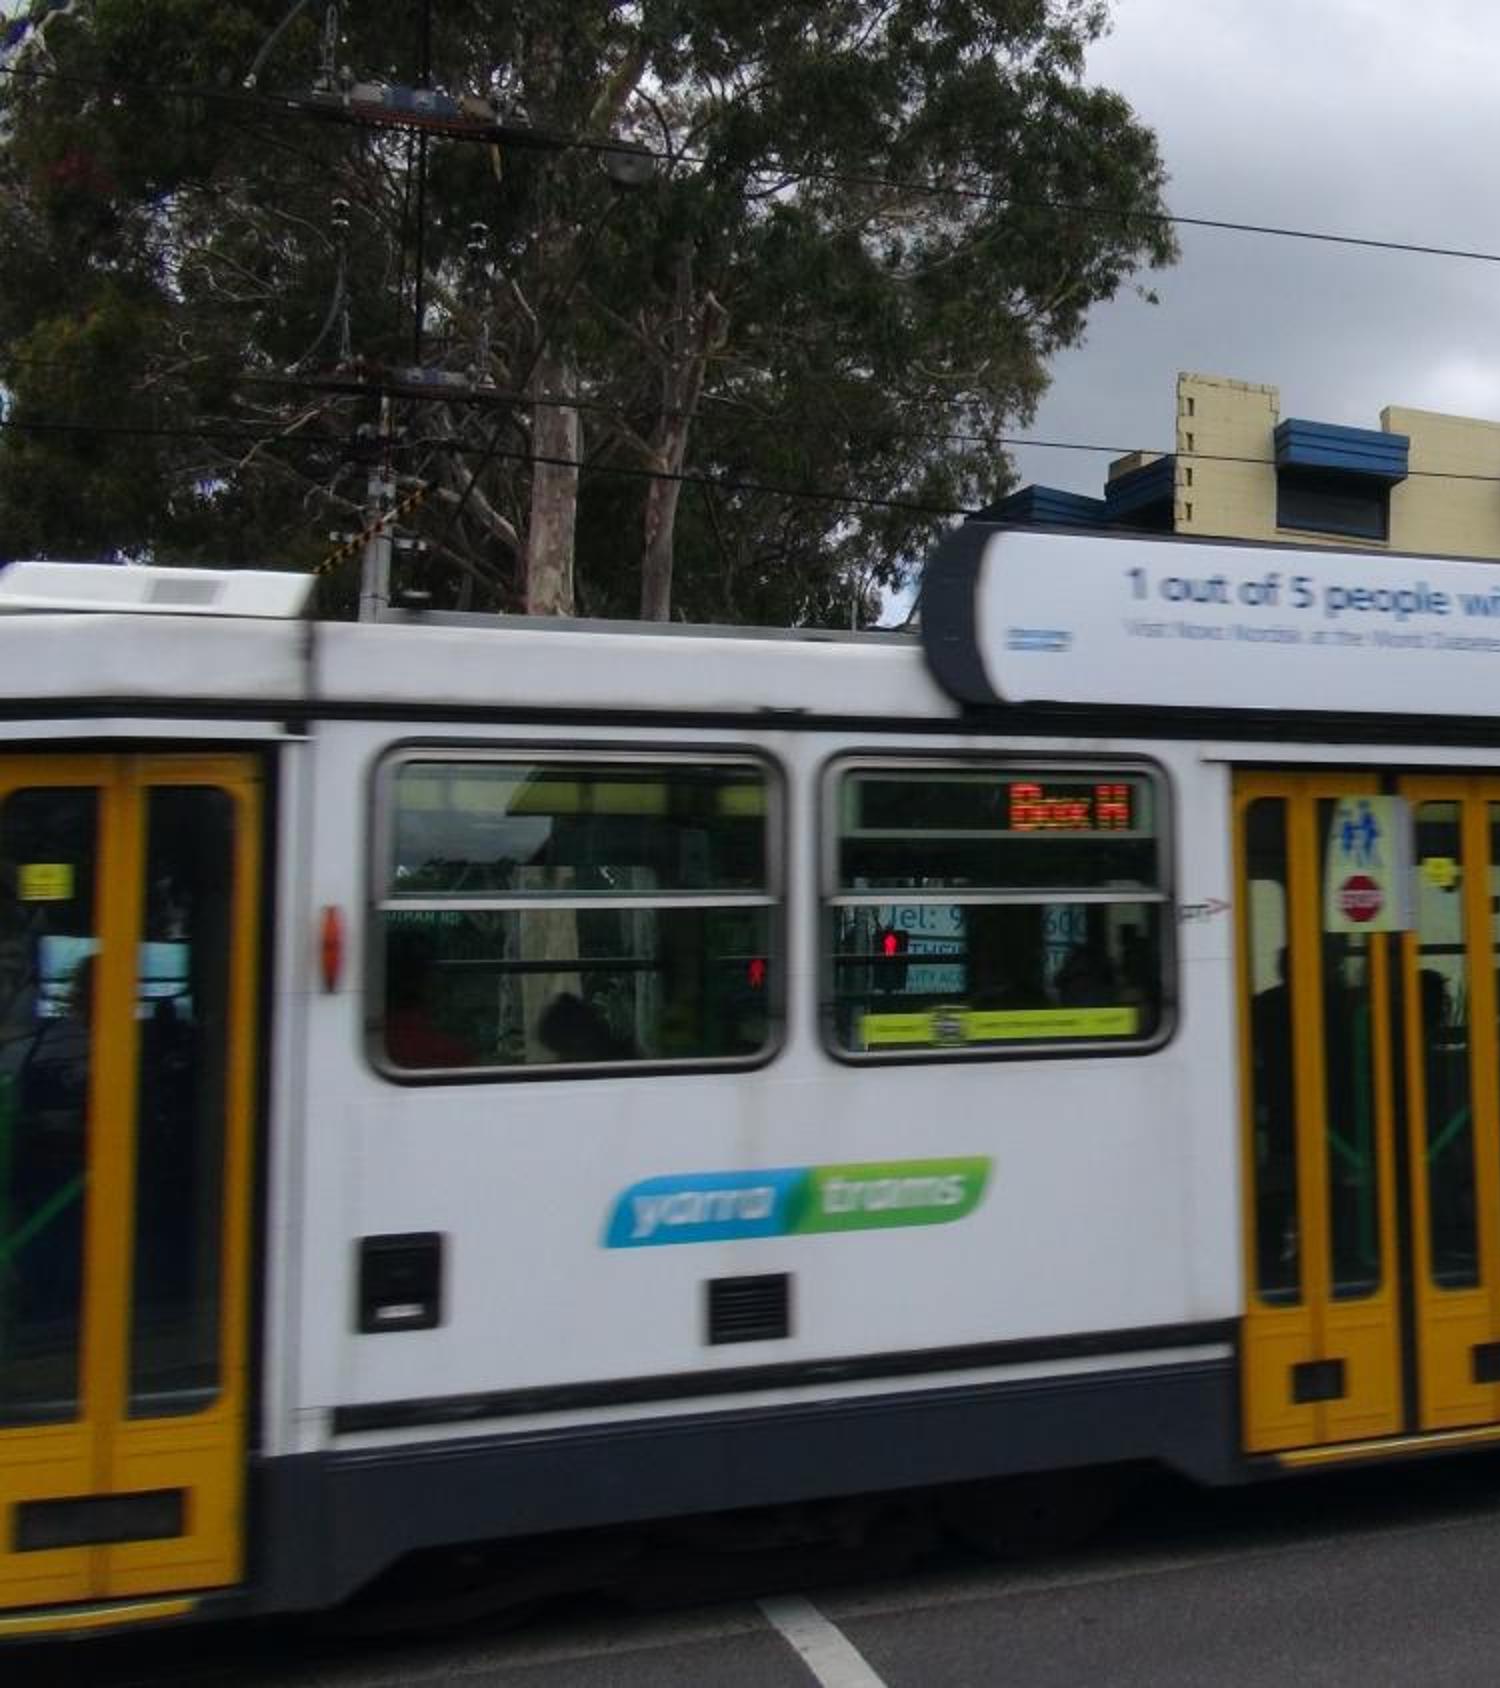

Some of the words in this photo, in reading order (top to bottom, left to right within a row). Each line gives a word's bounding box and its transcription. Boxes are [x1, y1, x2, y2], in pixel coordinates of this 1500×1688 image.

[1124, 566, 1147, 600] 1
[1159, 574, 1231, 604] out
[1237, 572, 1281, 606] of
[1290, 575, 1315, 609] 5
[1324, 580, 1451, 622] people
[821, 1175, 969, 1214] trams
